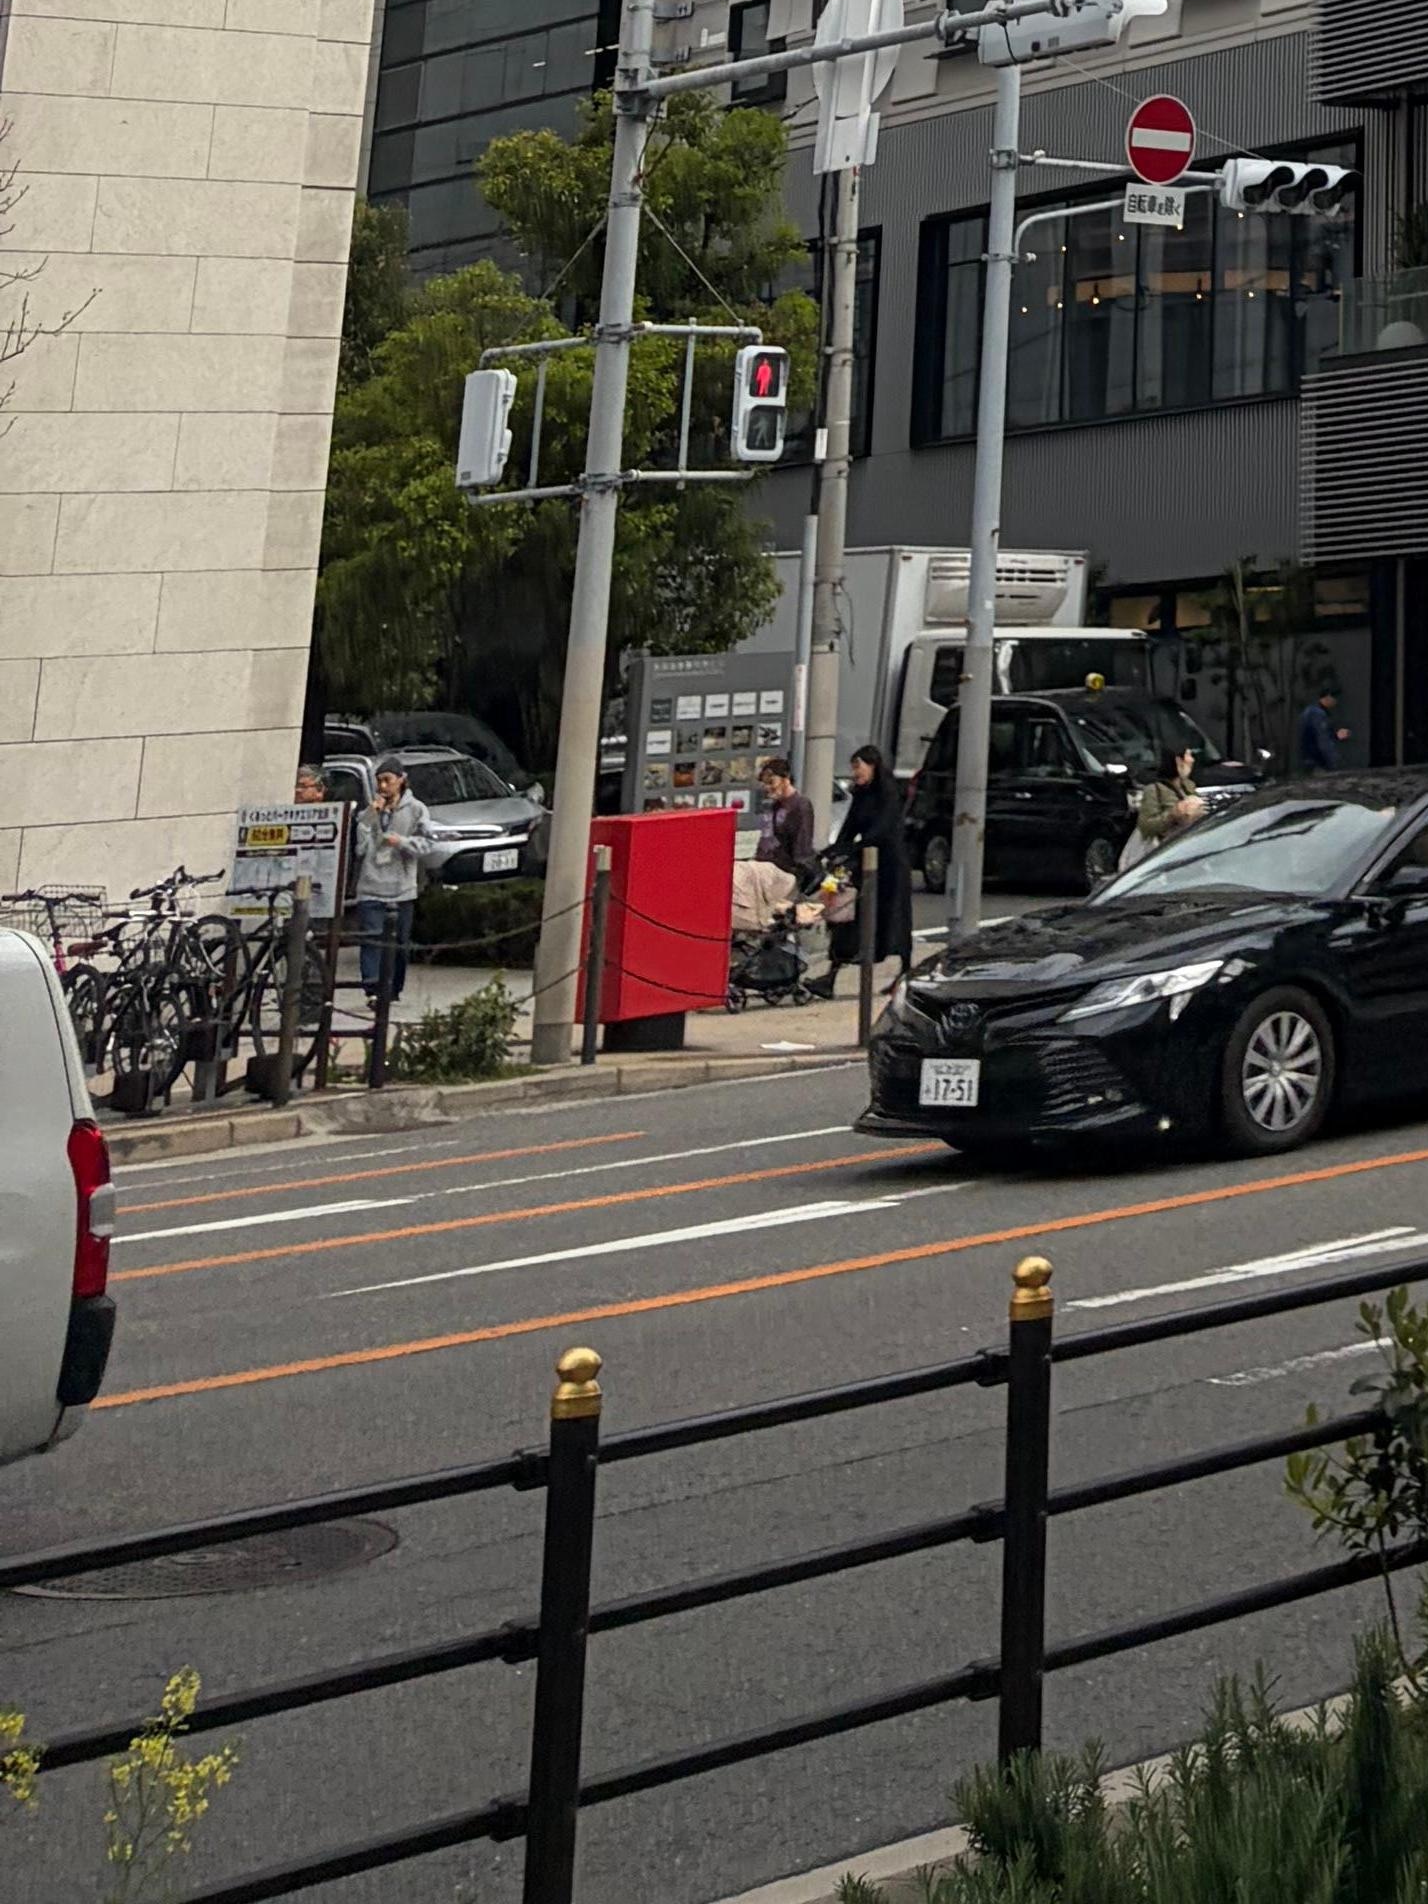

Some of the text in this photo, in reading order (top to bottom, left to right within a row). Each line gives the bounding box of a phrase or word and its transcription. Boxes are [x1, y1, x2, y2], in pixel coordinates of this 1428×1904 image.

[1127, 194, 1181, 217] 自転車を除く
